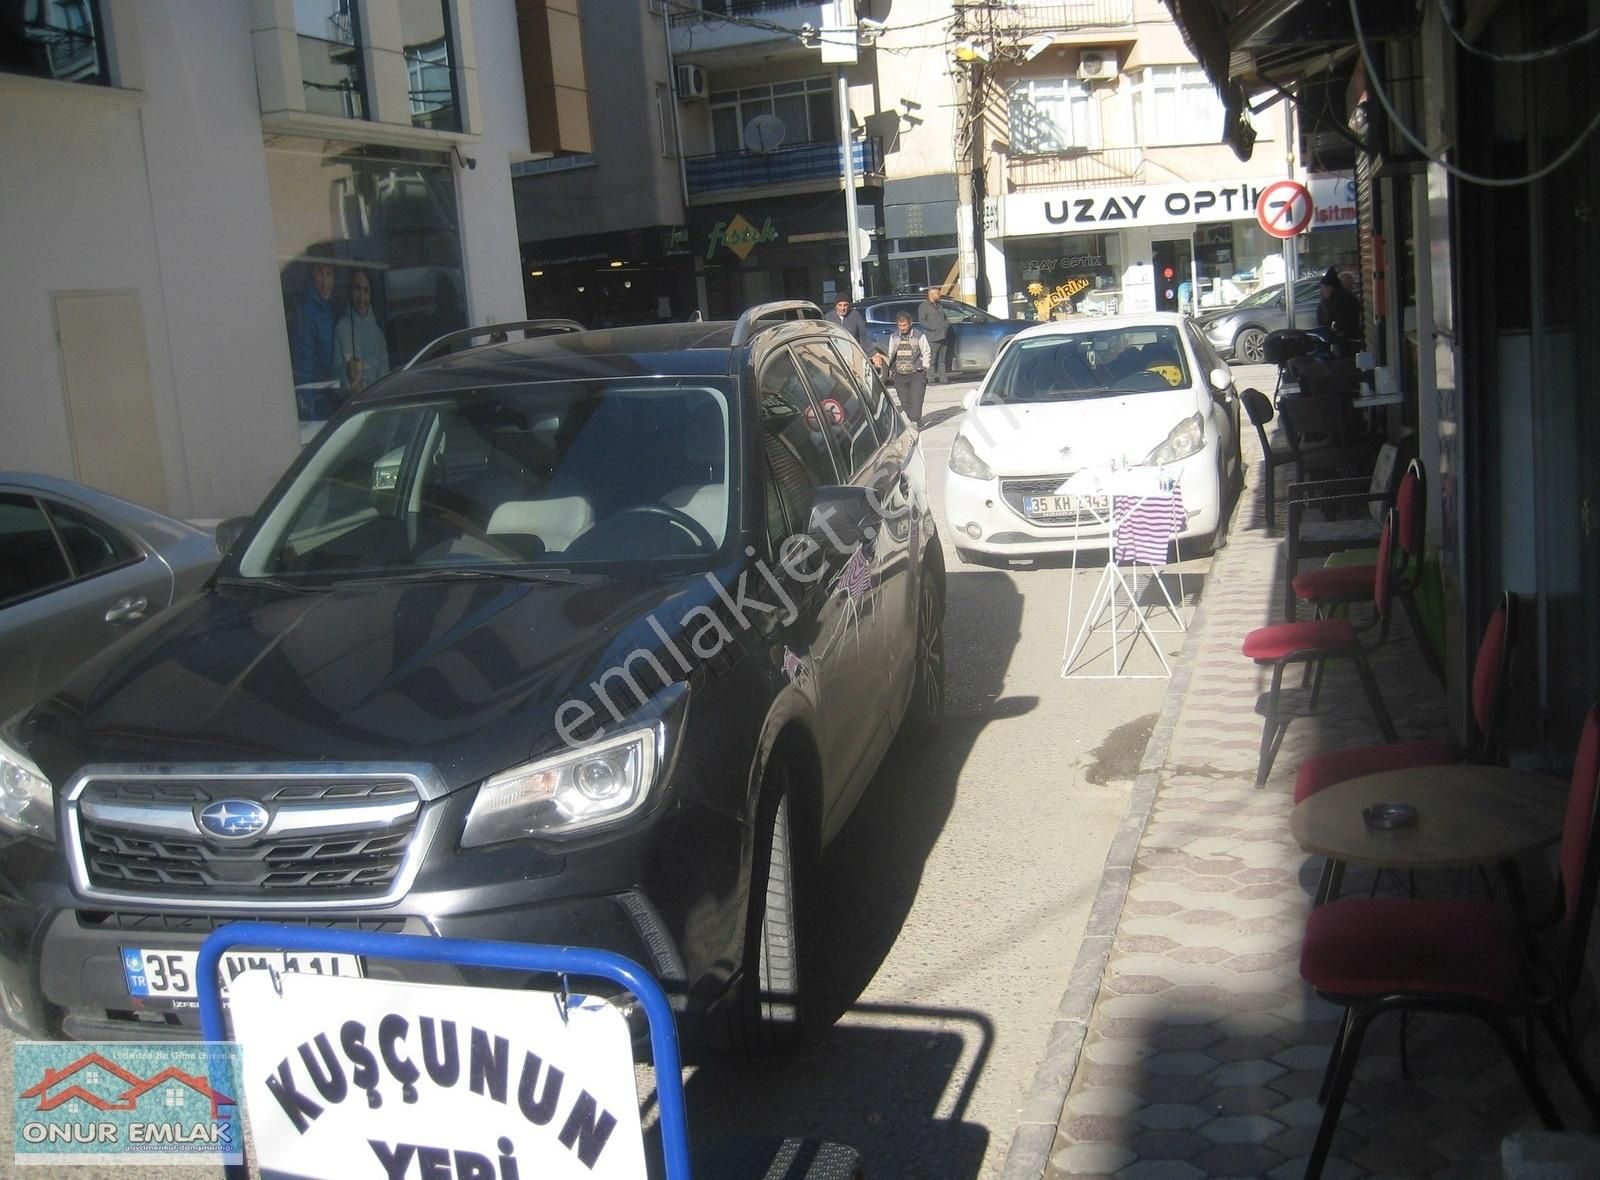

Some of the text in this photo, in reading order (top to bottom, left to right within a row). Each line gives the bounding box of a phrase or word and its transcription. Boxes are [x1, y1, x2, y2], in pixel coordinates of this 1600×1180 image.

[1044, 195, 1146, 224] UZAY
[1019, 259, 1058, 272] UZAY
[1031, 499, 1048, 512] 35
[1055, 497, 1071, 510] KH
[131, 975, 147, 987] TR
[146, 954, 190, 992] 35
[264, 1013, 618, 1170] KUŞÇUNUN
